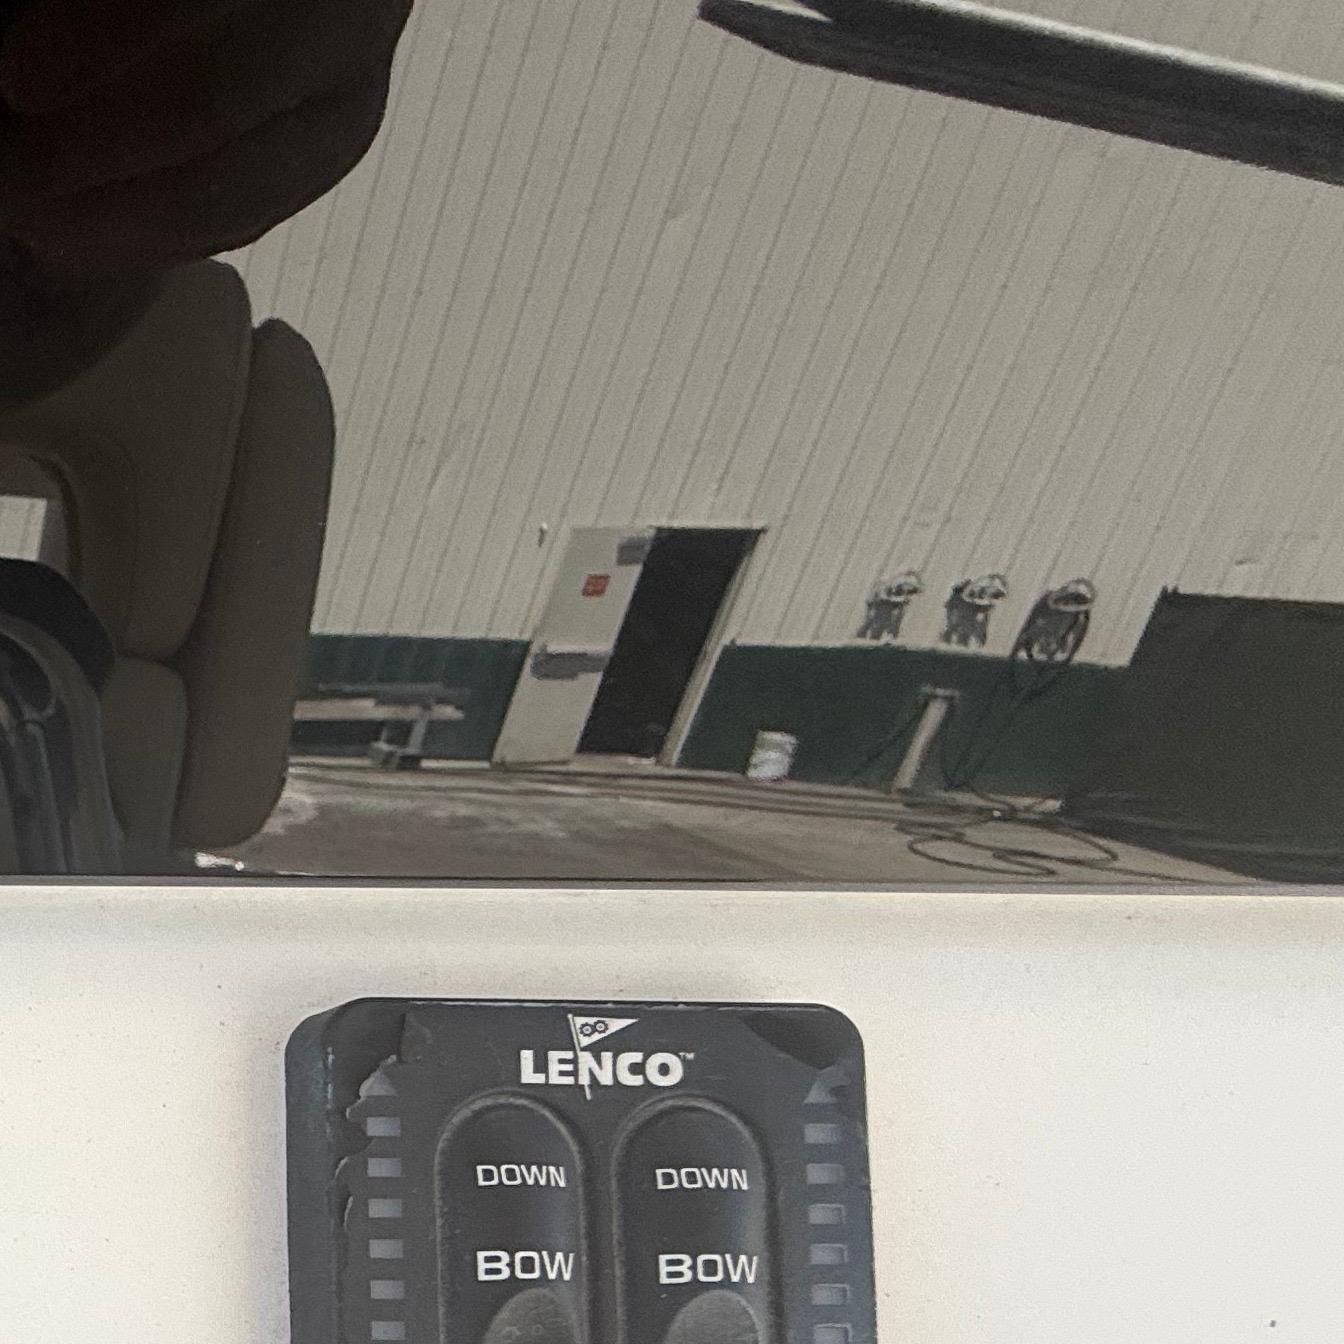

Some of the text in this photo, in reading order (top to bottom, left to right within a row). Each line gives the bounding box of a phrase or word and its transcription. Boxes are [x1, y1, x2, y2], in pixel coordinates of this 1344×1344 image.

[476, 1164, 566, 1188] DOWN
[655, 1167, 749, 1190] DOWN
[476, 1250, 575, 1282] BOW
[658, 1253, 758, 1285] BOW
